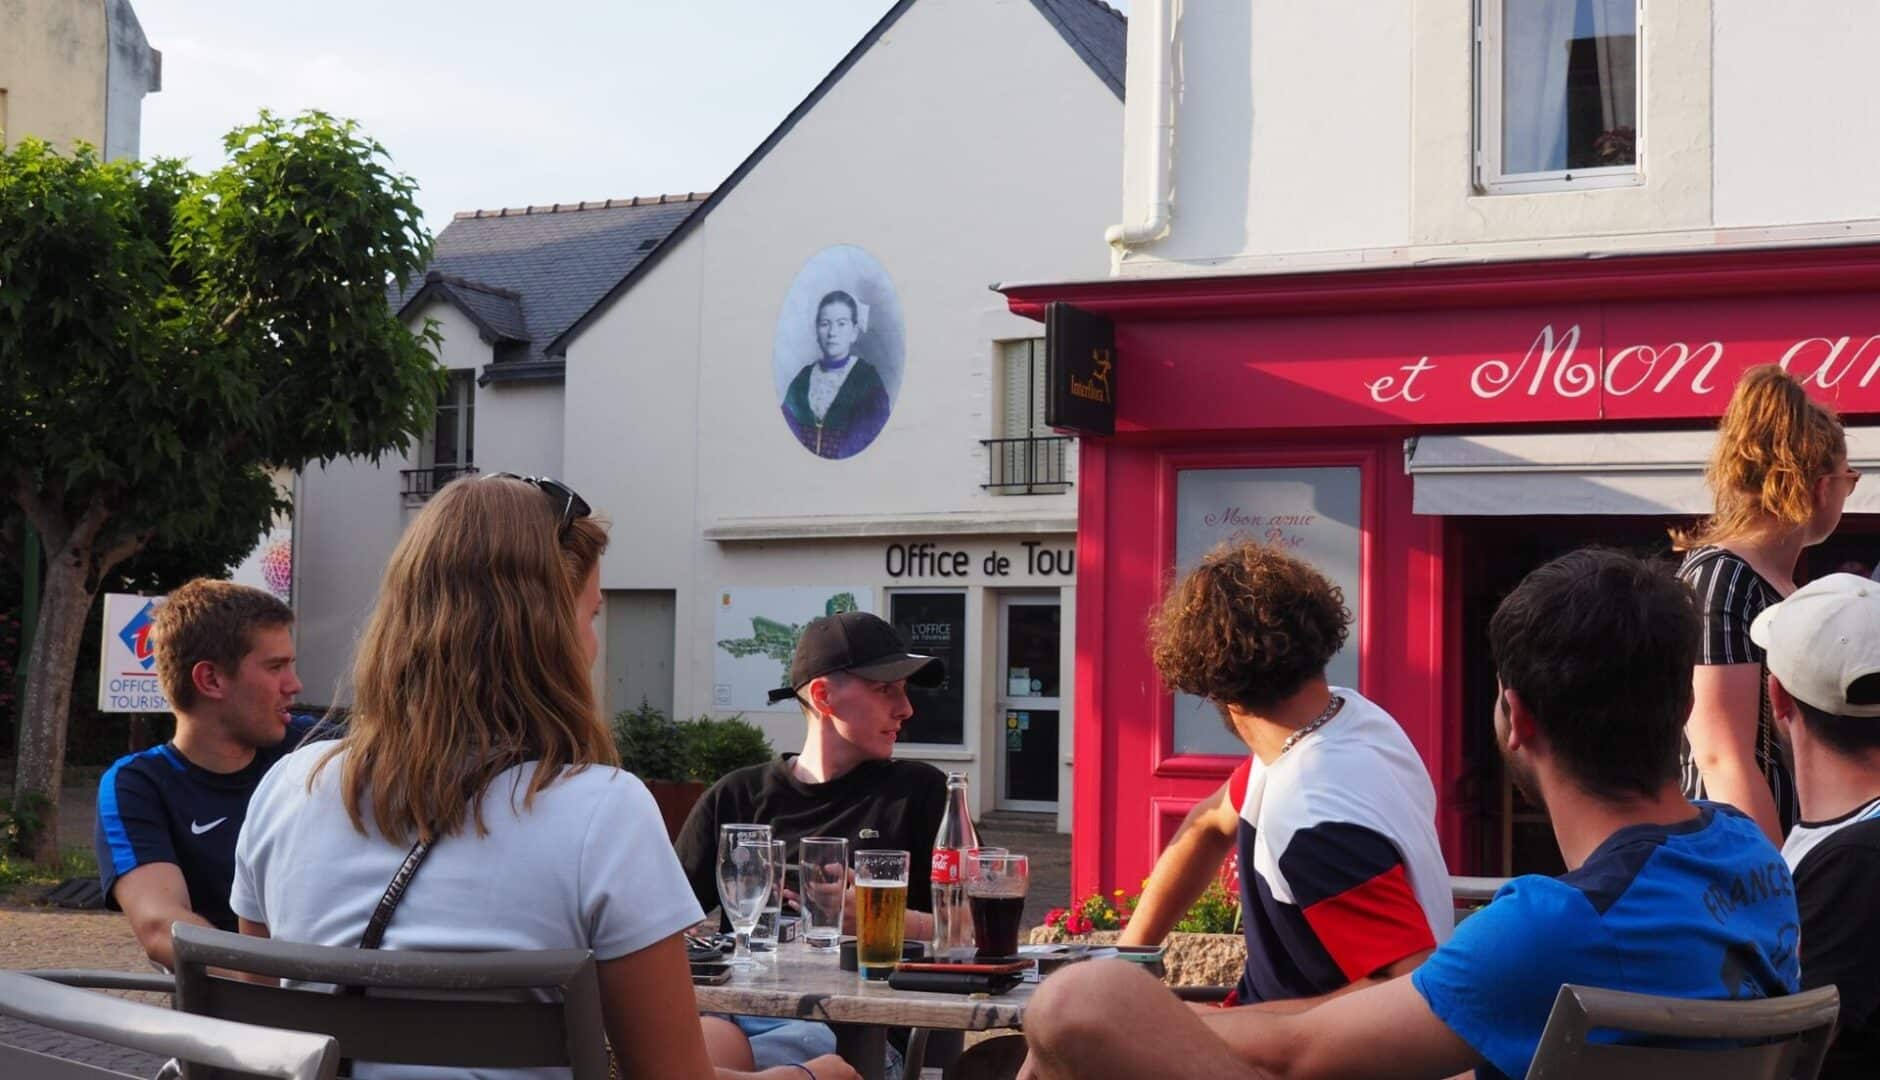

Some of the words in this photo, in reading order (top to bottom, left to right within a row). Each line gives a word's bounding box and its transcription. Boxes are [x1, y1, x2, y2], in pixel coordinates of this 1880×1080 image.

[1364, 355, 1438, 403] et
[1470, 324, 1723, 398] Mon
[1203, 506, 1263, 527] Mon
[1266, 515, 1315, 528] amie
[886, 543, 969, 577] Office
[983, 550, 1011, 576] de
[1021, 541, 1074, 576] Tou
[109, 679, 159, 693] OFFICE
[1703, 862, 1793, 926] FRANCE
